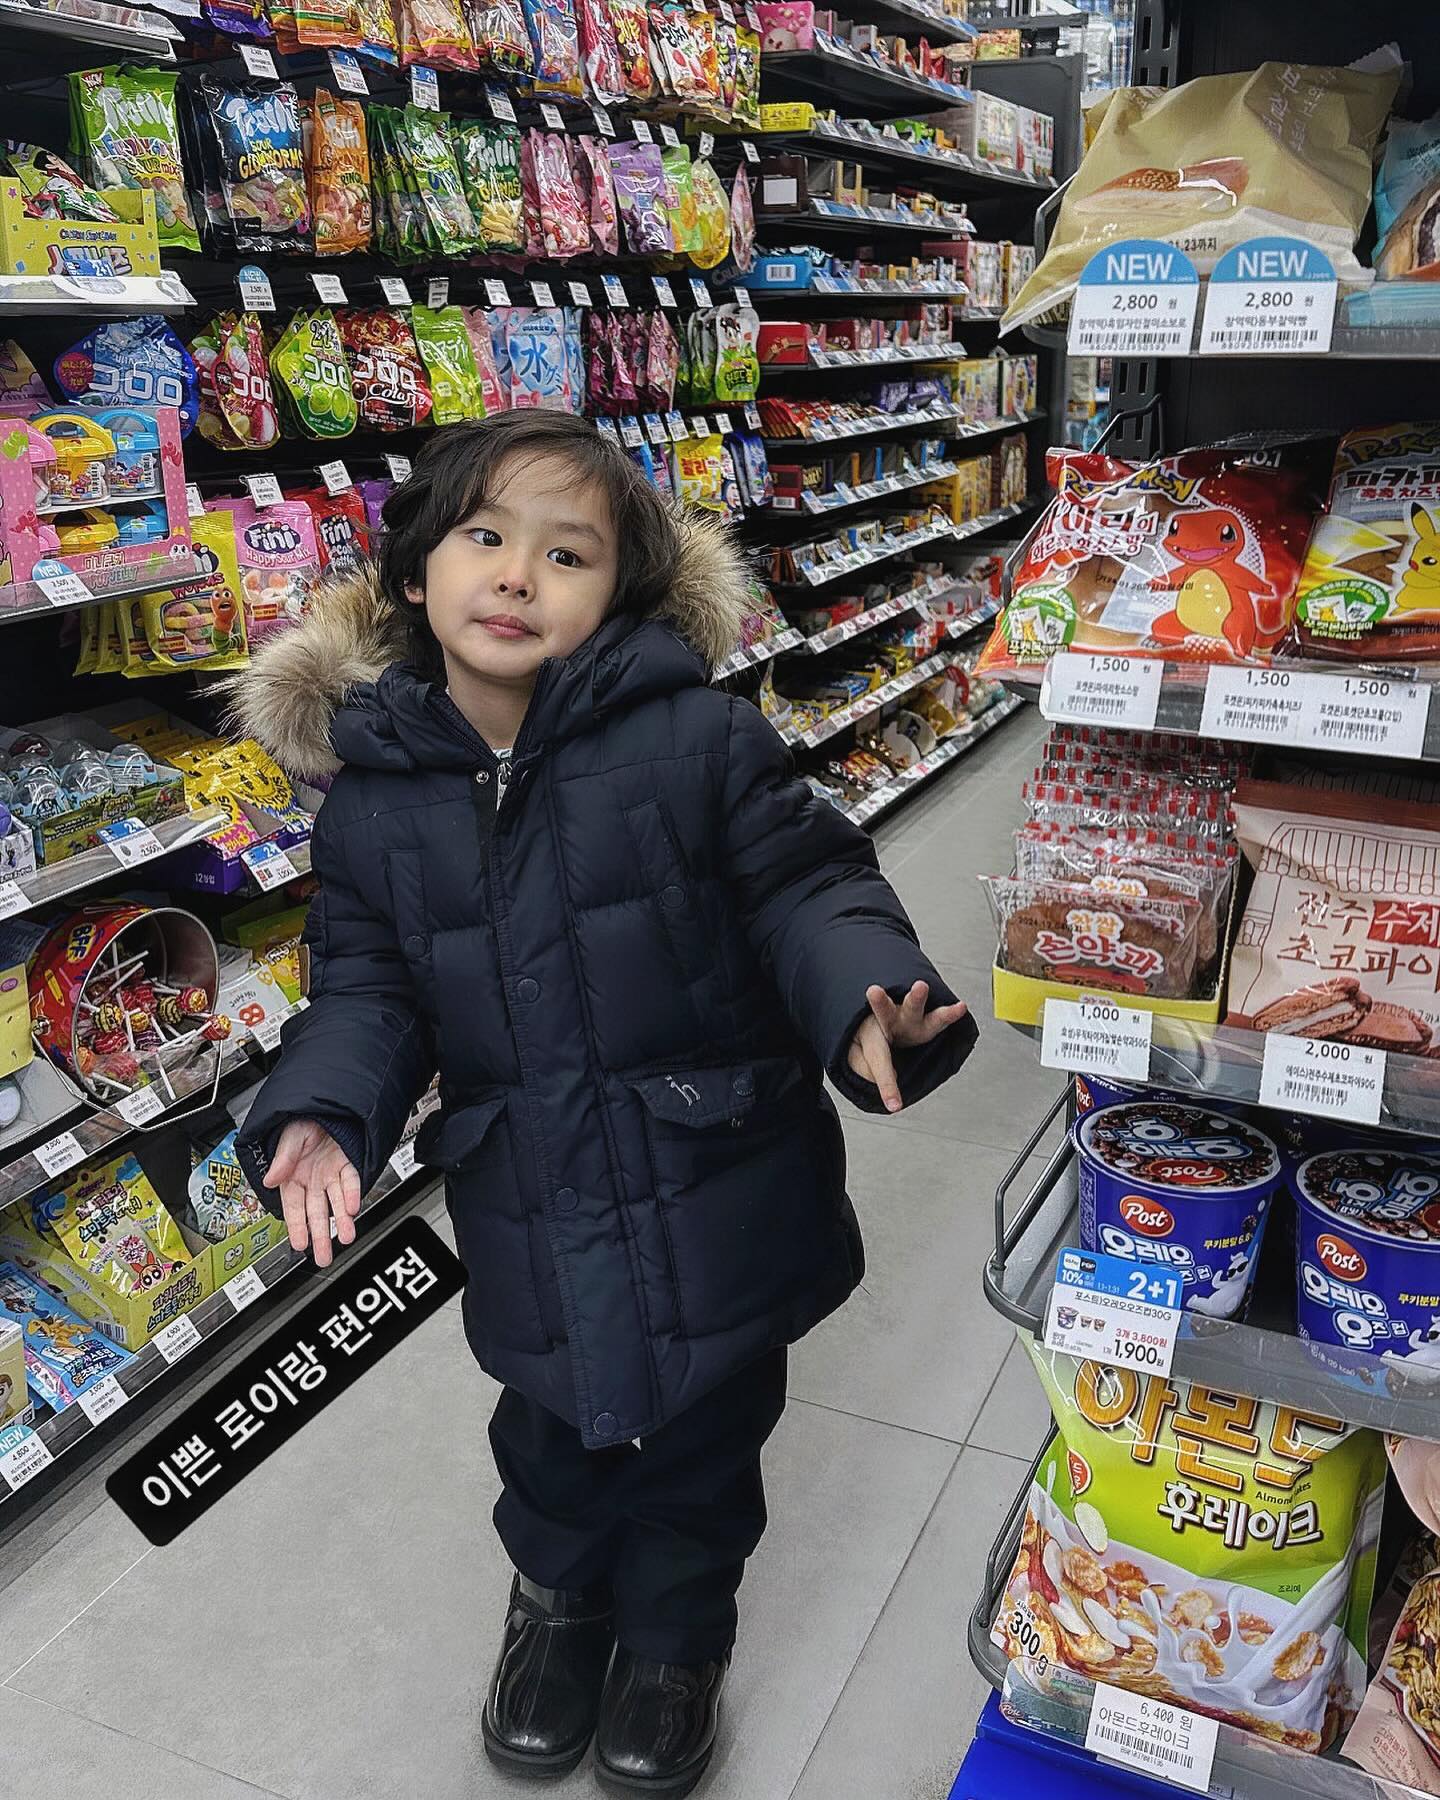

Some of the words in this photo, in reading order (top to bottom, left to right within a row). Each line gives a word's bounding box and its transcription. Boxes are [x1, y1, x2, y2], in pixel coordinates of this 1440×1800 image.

[1107, 254, 1173, 280] NEW
[1237, 250, 1308, 277] NEW
[1112, 295, 1158, 312] 2,800
[1245, 292, 1293, 309] 2,800
[520, 334, 549, 383] 水
[38, 564, 64, 578] NEW
[247, 551, 276, 567] Happy
[1089, 657, 1131, 672] 1,500
[1246, 670, 1290, 687] 1,500
[1344, 679, 1390, 697] 1,500
[1293, 891, 1369, 936] 전주
[1036, 934, 1161, 977] 손약과
[1080, 1005, 1120, 1021] 1,000
[1305, 1041, 1350, 1061] 2,000
[1364, 1055, 1373, 1064] 원
[209, 1161, 241, 1189] 디지몬
[1161, 1166, 1221, 1180] Post
[1124, 1202, 1169, 1228] Post
[1104, 1228, 1192, 1266] 오레오
[1321, 1242, 1360, 1272] Post
[1062, 1269, 1084, 1286] 10%
[1127, 1271, 1178, 1307] 2+1
[1304, 1265, 1387, 1317] 오레오
[1115, 1327, 1131, 1338] 3개
[1132, 1330, 1168, 1349] 3,800원
[1337, 1311, 1388, 1346] 오즈
[1075, 1360, 1344, 1487] 아몬드
[1158, 1481, 1323, 1549] 후레이크
[1010, 1611, 1042, 1657] 300
[1098, 1706, 1191, 1750] 아몬드후레이크
[1139, 1702, 1175, 1724] 6,400
[1180, 1714, 1194, 1733] 원
